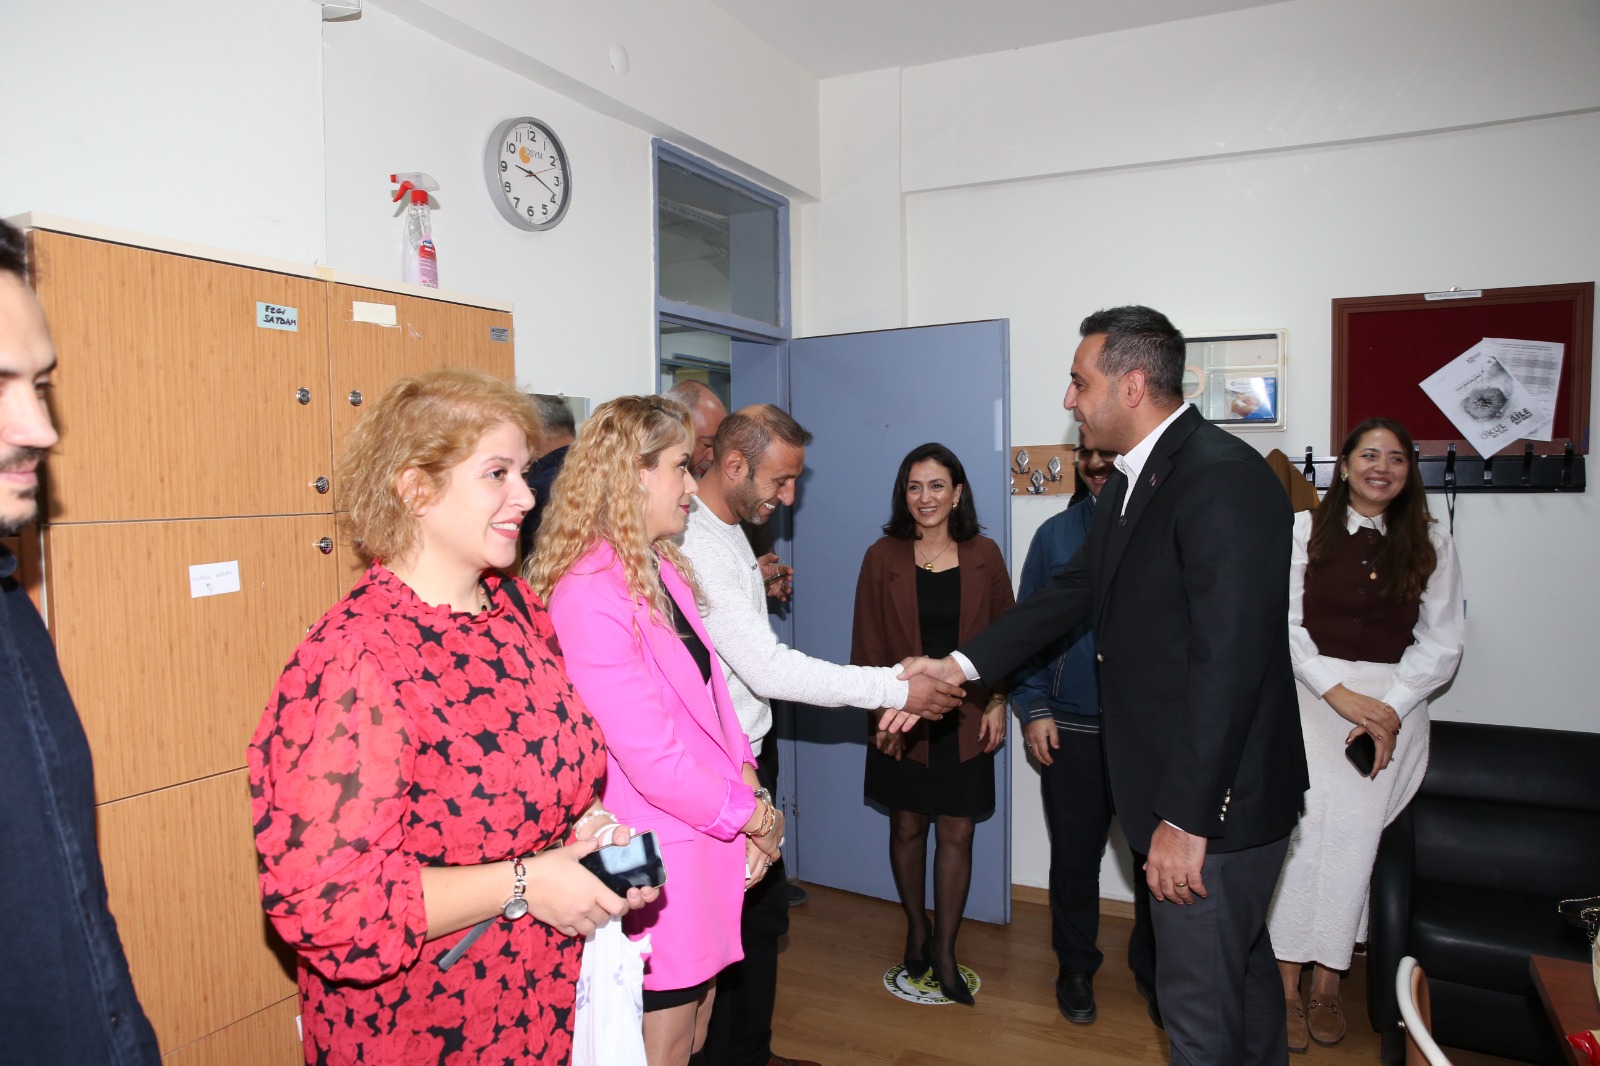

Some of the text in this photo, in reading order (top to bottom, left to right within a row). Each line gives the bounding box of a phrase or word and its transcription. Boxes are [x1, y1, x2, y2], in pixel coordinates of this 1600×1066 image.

[515, 131, 521, 143] 11
[527, 130, 536, 142] 12
[506, 141, 516, 154] 10
[500, 161, 508, 172] 9
[550, 156, 556, 166] 2
[554, 176, 560, 186] 3
[504, 182, 511, 192] 8
[513, 197, 520, 208] 7
[550, 194, 556, 204] 4
[527, 206, 534, 216] 6
[542, 204, 548, 215] 5
[1510, 408, 1530, 423] AİLE
[1481, 423, 1506, 439] OKUL
